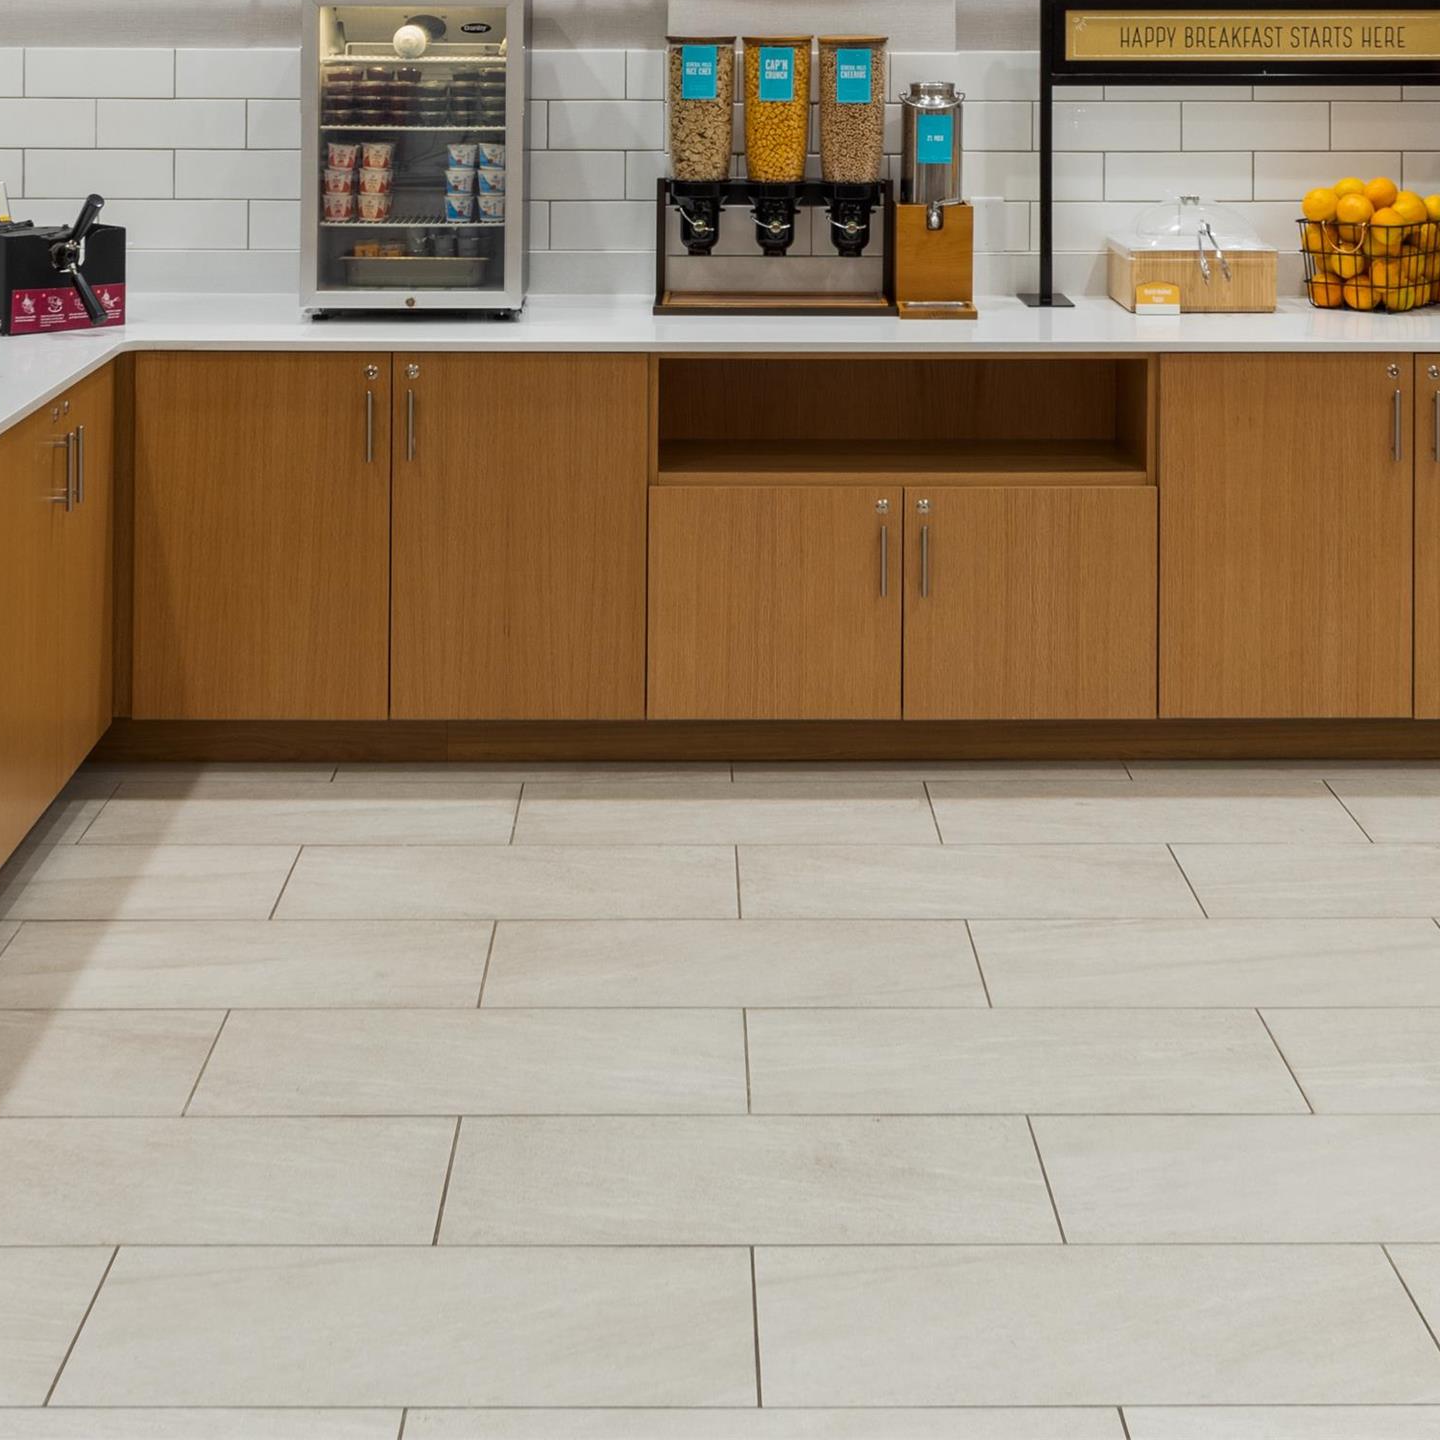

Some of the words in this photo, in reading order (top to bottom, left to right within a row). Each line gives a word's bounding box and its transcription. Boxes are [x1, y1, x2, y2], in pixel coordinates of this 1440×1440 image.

[1119, 26, 1176, 49] HAPPY
[1184, 26, 1284, 49] BREAKFAST
[1290, 26, 1354, 49] STARTS
[1361, 26, 1407, 49] HERE
[765, 59, 788, 71] CAP'N
